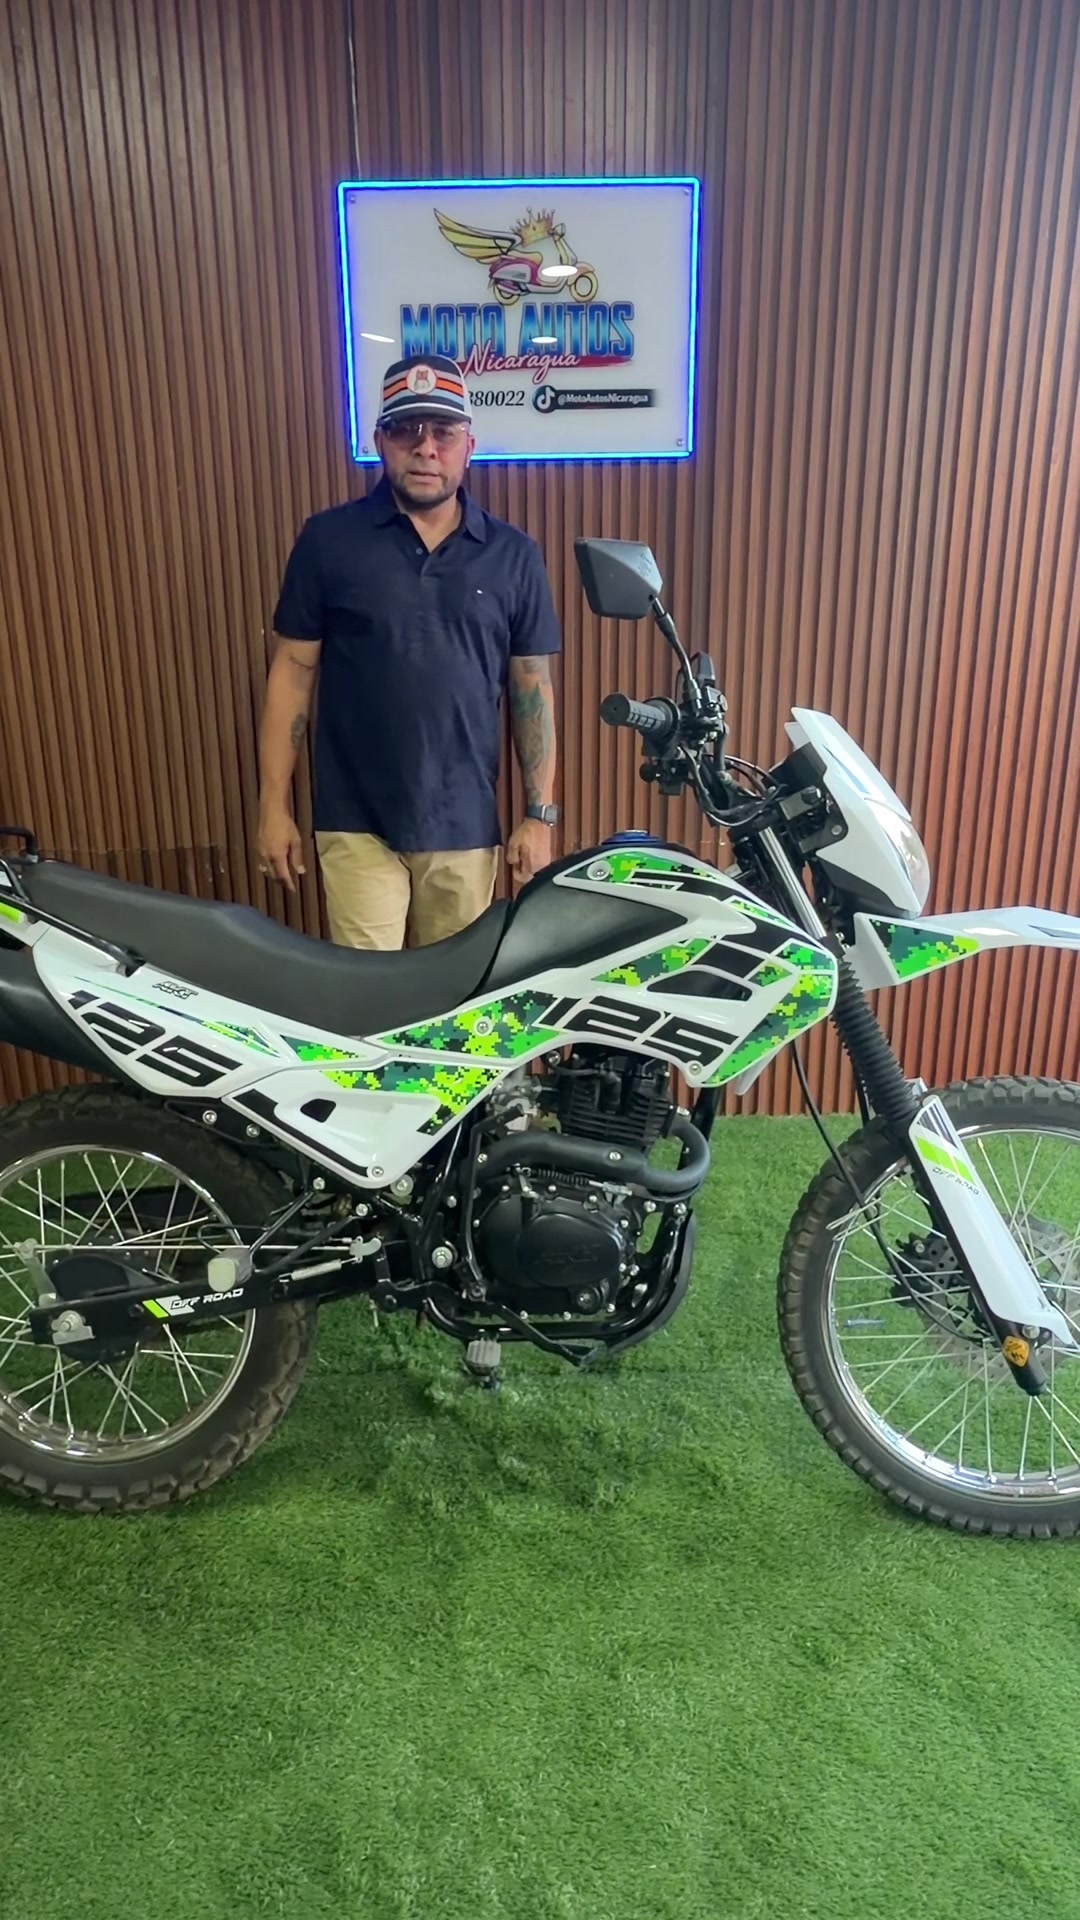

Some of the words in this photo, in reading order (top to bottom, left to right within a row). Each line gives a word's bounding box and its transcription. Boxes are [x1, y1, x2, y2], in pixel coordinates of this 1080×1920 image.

[400, 304, 506, 361] MOTO
[518, 301, 634, 359] AUTOS
[462, 338, 580, 385] Nicaragua
[558, 393, 649, 406] @MotoAutosNicaragua
[68, 990, 243, 1087] 125
[538, 996, 739, 1067] 125
[171, 1296, 201, 1310] OFF
[203, 1288, 244, 1304] ROAD
